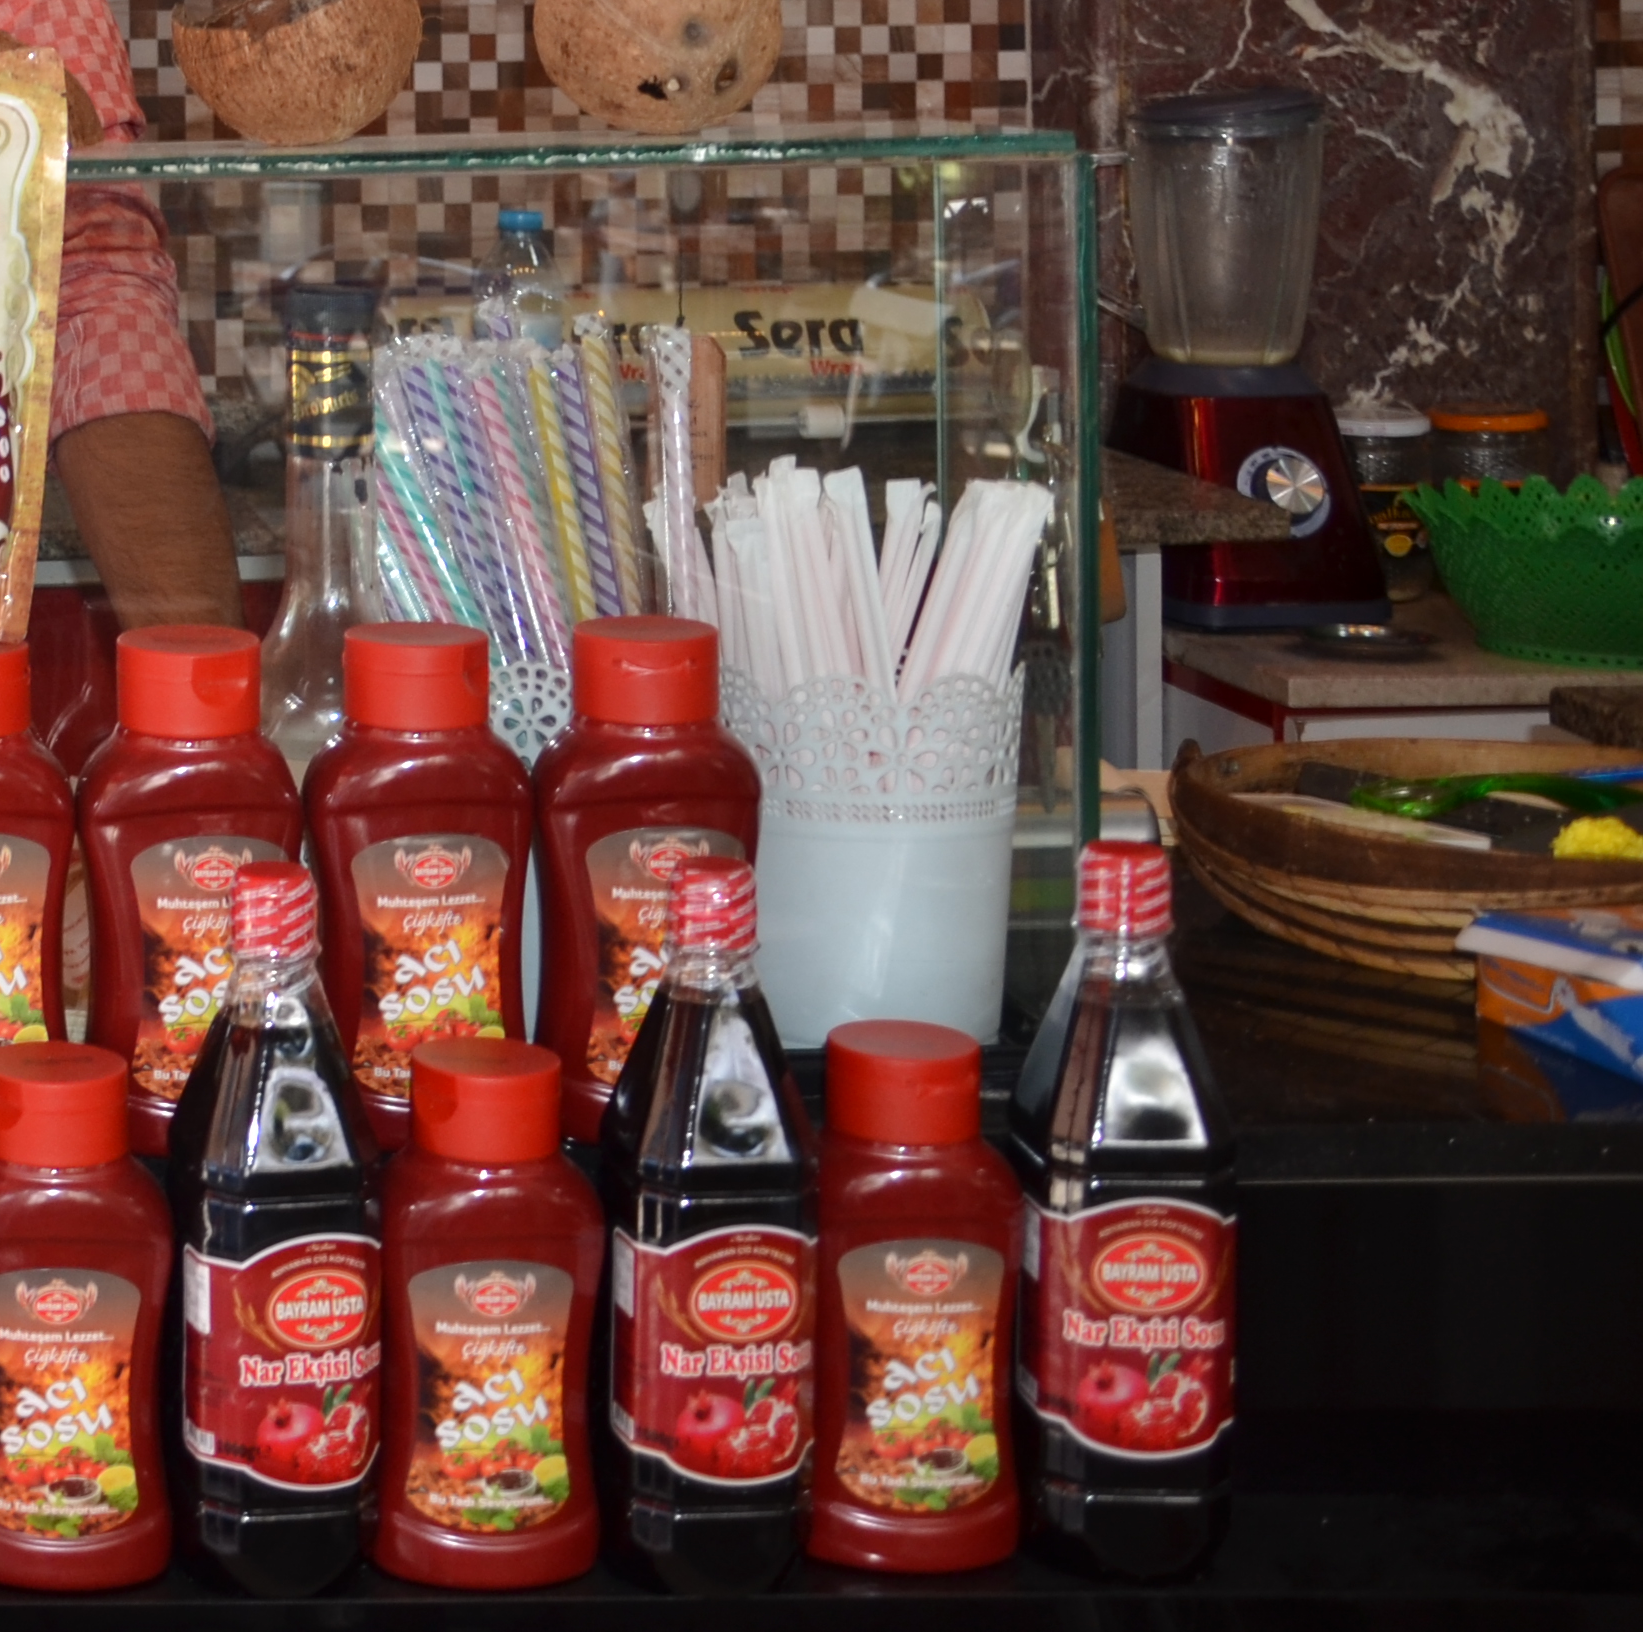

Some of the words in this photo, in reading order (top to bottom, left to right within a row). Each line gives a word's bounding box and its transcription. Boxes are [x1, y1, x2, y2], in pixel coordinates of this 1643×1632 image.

[377, 895, 437, 909] Muhteşem
[1102, 1262, 1159, 1282] BAYRAM
[1162, 1263, 1198, 1282] USTA
[275, 1299, 328, 1321] BAYRAM
[330, 1296, 365, 1317] USTA
[698, 1292, 754, 1311] BAYRAM
[755, 1288, 790, 1309] USTA
[1063, 1310, 1108, 1346] Nar
[1109, 1315, 1180, 1353] Ekşisi
[240, 1350, 281, 1386] Nar
[282, 1350, 350, 1386] Ekşisi
[661, 1341, 705, 1377] Nar
[706, 1342, 774, 1381] Ekşisi
